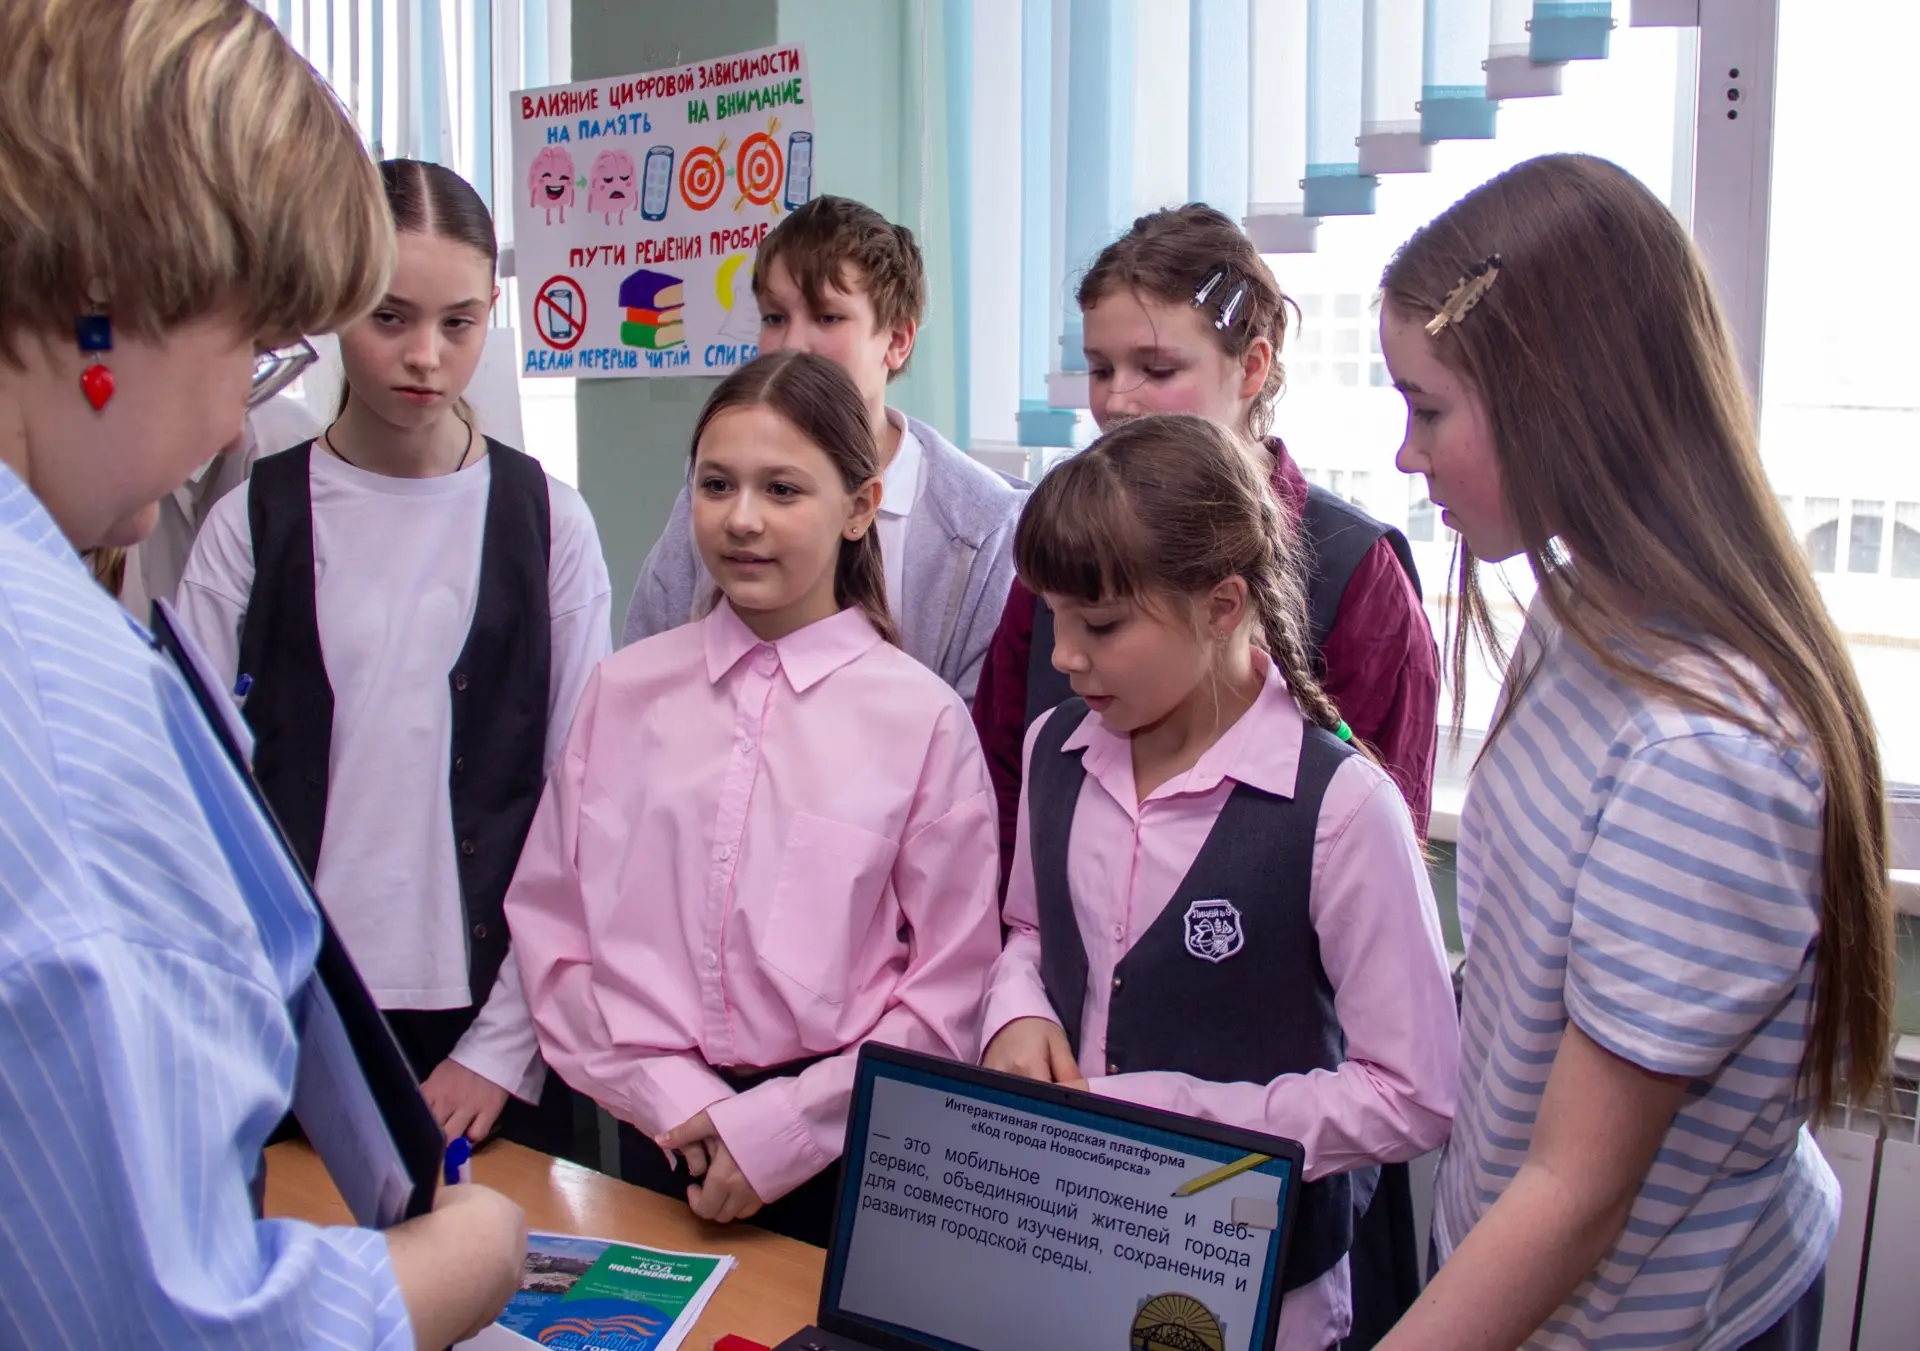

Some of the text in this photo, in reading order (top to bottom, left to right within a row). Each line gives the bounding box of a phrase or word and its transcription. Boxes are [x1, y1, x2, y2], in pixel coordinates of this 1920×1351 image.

[521, 49, 800, 120] ВЛИЯНИЕ ЦИФРОВОЙ ЗАВИСИМОСТИ
[688, 78, 804, 124] НА ВНИМАНИЕ
[547, 112, 652, 144] НА ПАМЯТЬ
[569, 222, 775, 268] ПУТИ РЕШЕНИЯ ПРОБЛЕ
[525, 347, 638, 372] ДЕЛАЙ ПЕРЕРЫВ
[645, 345, 690, 368] ЧИТАЙ
[704, 344, 736, 368] СПИ
[945, 1097, 1186, 1169] Интерактивная городская платформа
[971, 1121, 1151, 1176] «Код города Новосибирска»
[869, 1151, 1250, 1268] сервис, объединяющий жителей города
[904, 1137, 931, 1155] это
[945, 1148, 1040, 1185] мобильное
[1055, 1178, 1168, 1220] приложение
[1184, 1212, 1196, 1228] и
[1213, 1219, 1255, 1241] веб-
[862, 1195, 1093, 1274] развития городской среды.
[864, 1172, 1247, 1293] для совместного изучения, сохранения и
[639, 1262, 672, 1274] КОД
